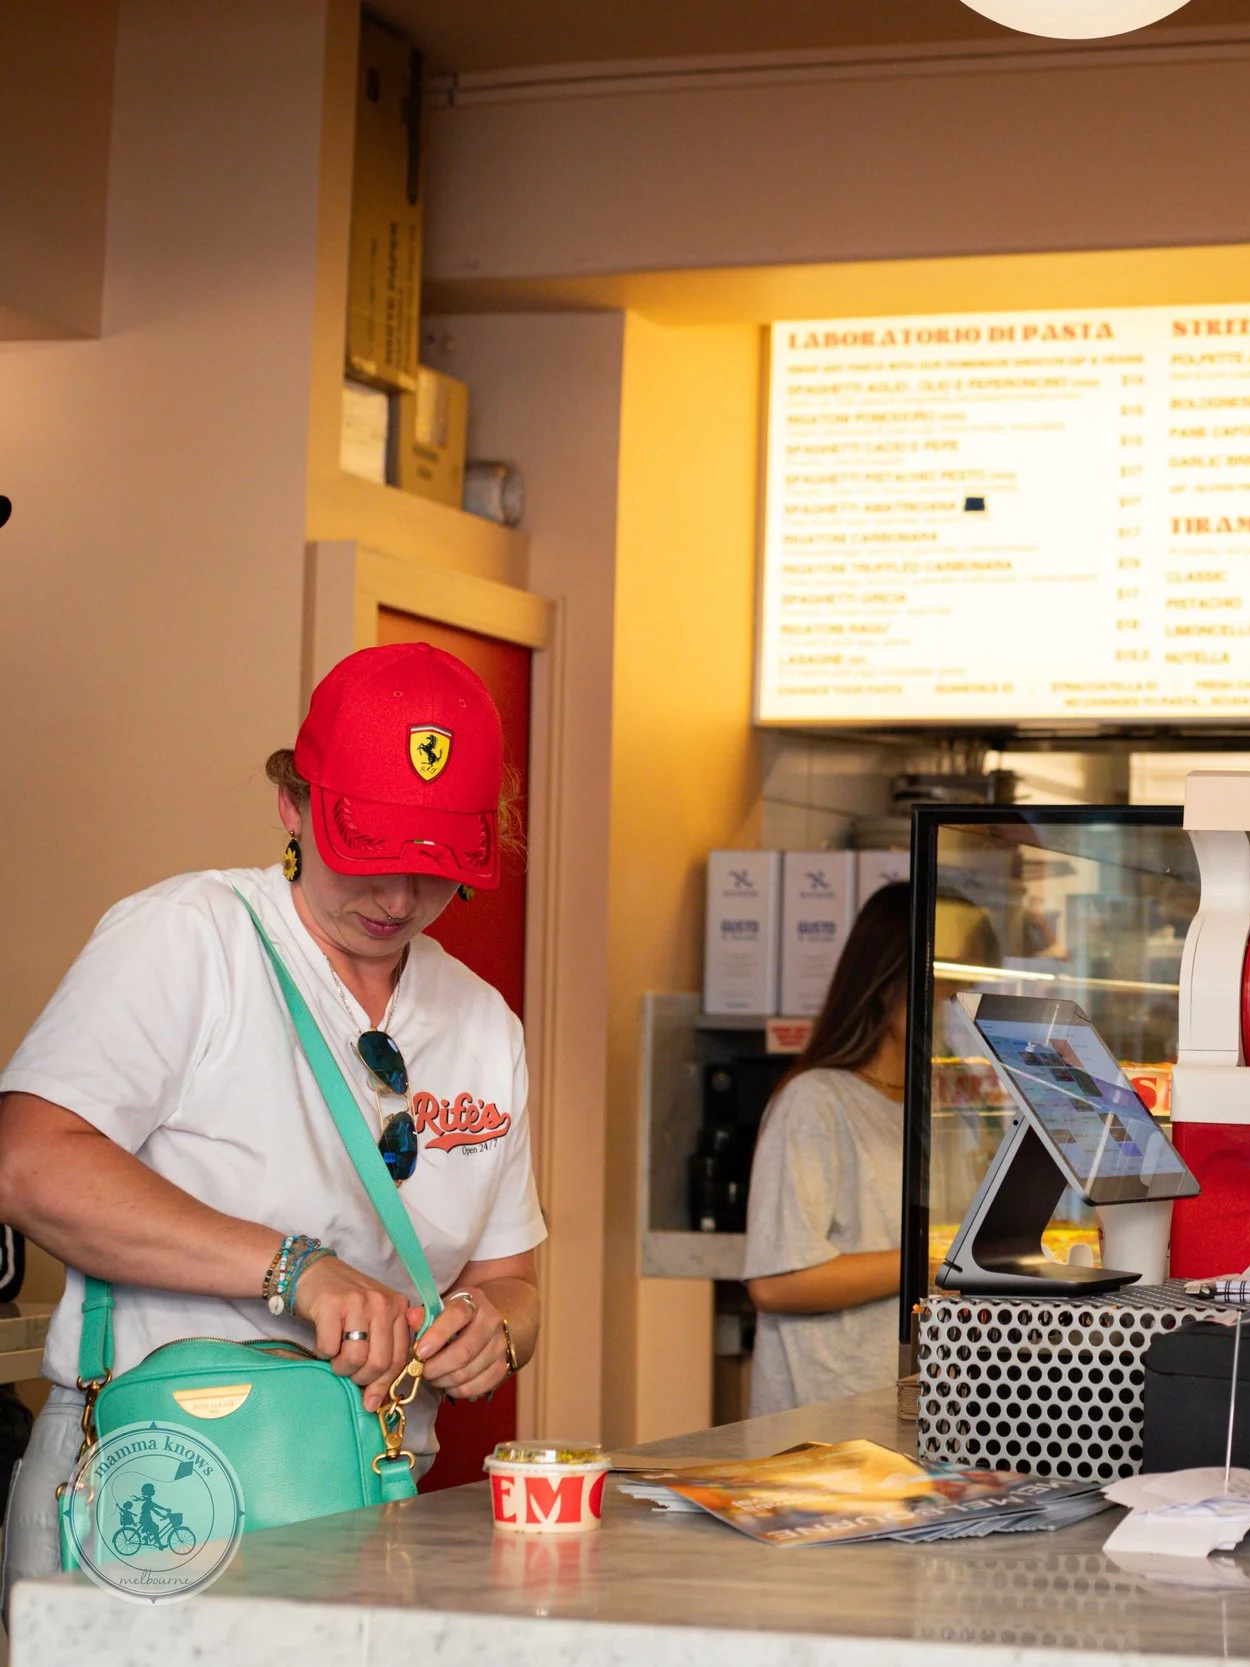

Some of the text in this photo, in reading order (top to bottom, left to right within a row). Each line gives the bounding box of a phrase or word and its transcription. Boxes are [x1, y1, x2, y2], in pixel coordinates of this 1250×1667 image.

[788, 320, 1115, 350] LABORATORIO DI PASTA
[1164, 650, 1231, 665] NUTELLA
[721, 920, 760, 934] GUSTO
[797, 921, 837, 935] GUSTO
[412, 1091, 511, 1136] Rife's
[462, 1145, 478, 1156] Open
